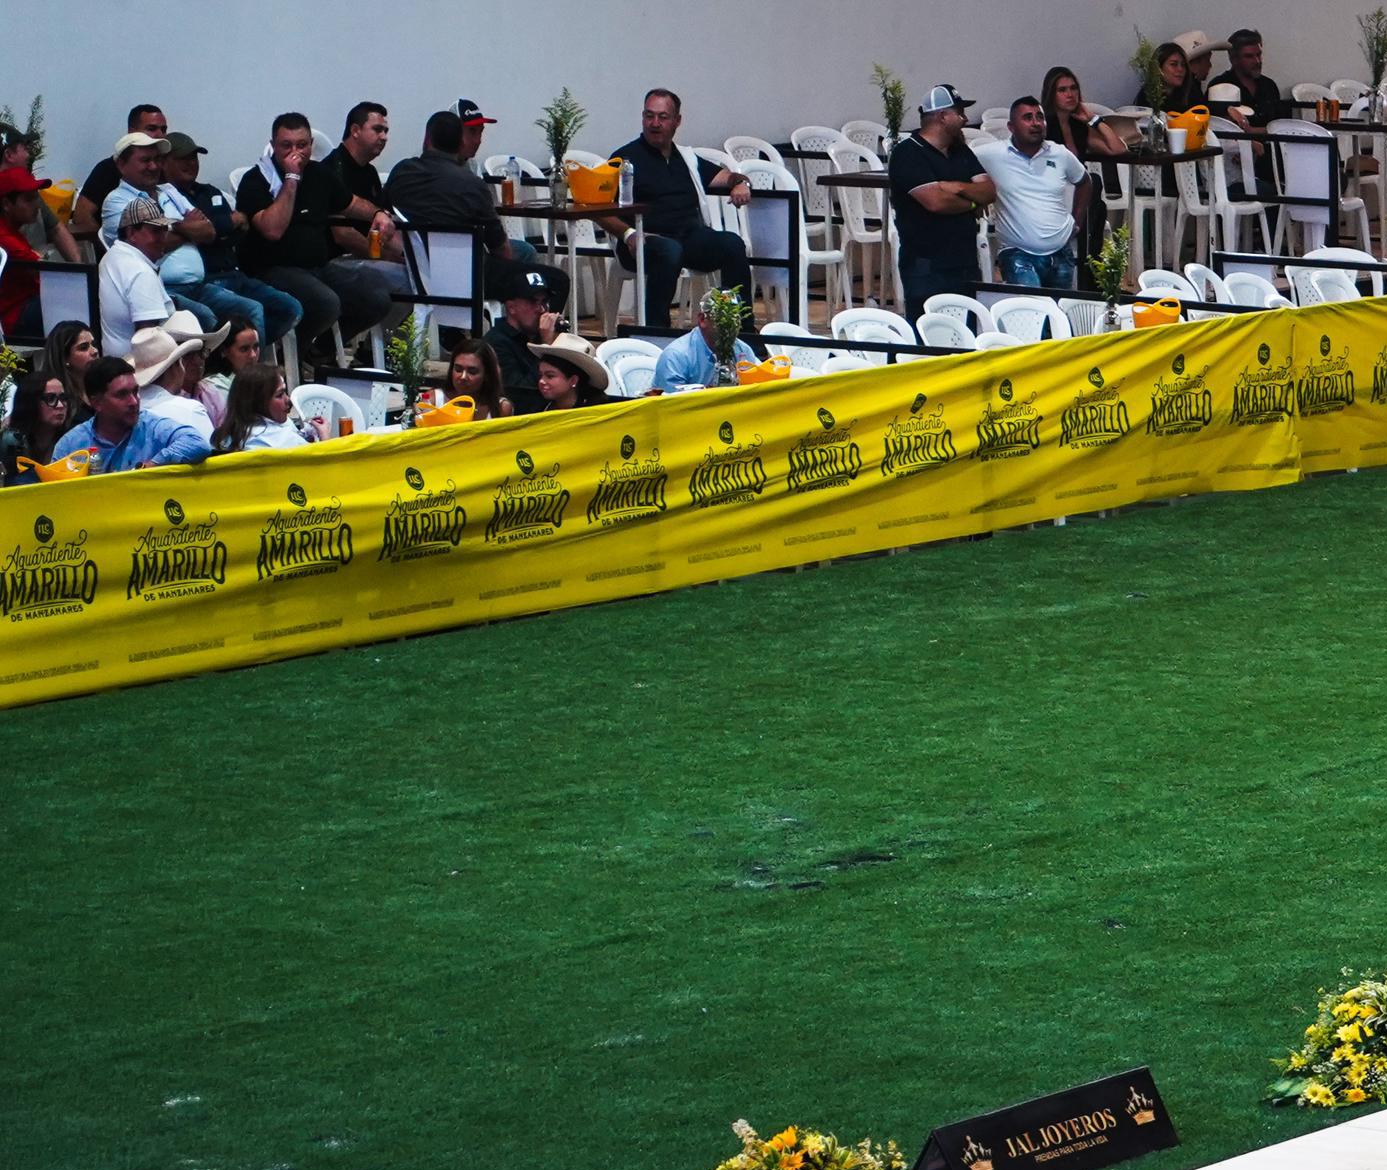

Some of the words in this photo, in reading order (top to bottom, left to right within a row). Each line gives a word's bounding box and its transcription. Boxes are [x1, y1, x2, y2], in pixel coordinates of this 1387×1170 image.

[1059, 401, 1131, 449] AMARILLO
[1146, 389, 1212, 435] AMARILLO
[1230, 383, 1297, 425] AMARILLO
[881, 429, 957, 477] AMARILLO
[969, 416, 1044, 461] AMARILLO
[496, 463, 560, 499] Aguardiente
[599, 448, 665, 482] Aguardiente
[689, 457, 768, 507] AMARILLO
[786, 443, 862, 492] AMARILLO
[262, 496, 342, 534] Aguardiente
[386, 479, 456, 515] Aguardiente
[485, 489, 570, 544] AMARILLO
[587, 474, 668, 524] AMARILLO
[2, 528, 88, 572] Aguardiente
[134, 512, 218, 552] Aguardiente
[256, 522, 353, 582] AMARILLO
[377, 505, 467, 562] AMARILLO
[508, 527, 554, 542] MANZANARES
[0, 559, 98, 618] AMARILLO
[127, 541, 227, 600] AMARILLO
[143, 592, 156, 601] DE
[158, 583, 216, 600] MANZANARES
[272, 574, 285, 583] DE
[287, 565, 339, 581] MANZANARES
[11, 612, 23, 622] DE
[26, 604, 83, 620] MANZANARES
[1006, 1132, 1040, 1158] JAL
[1039, 1108, 1117, 1148] JOYEROS
